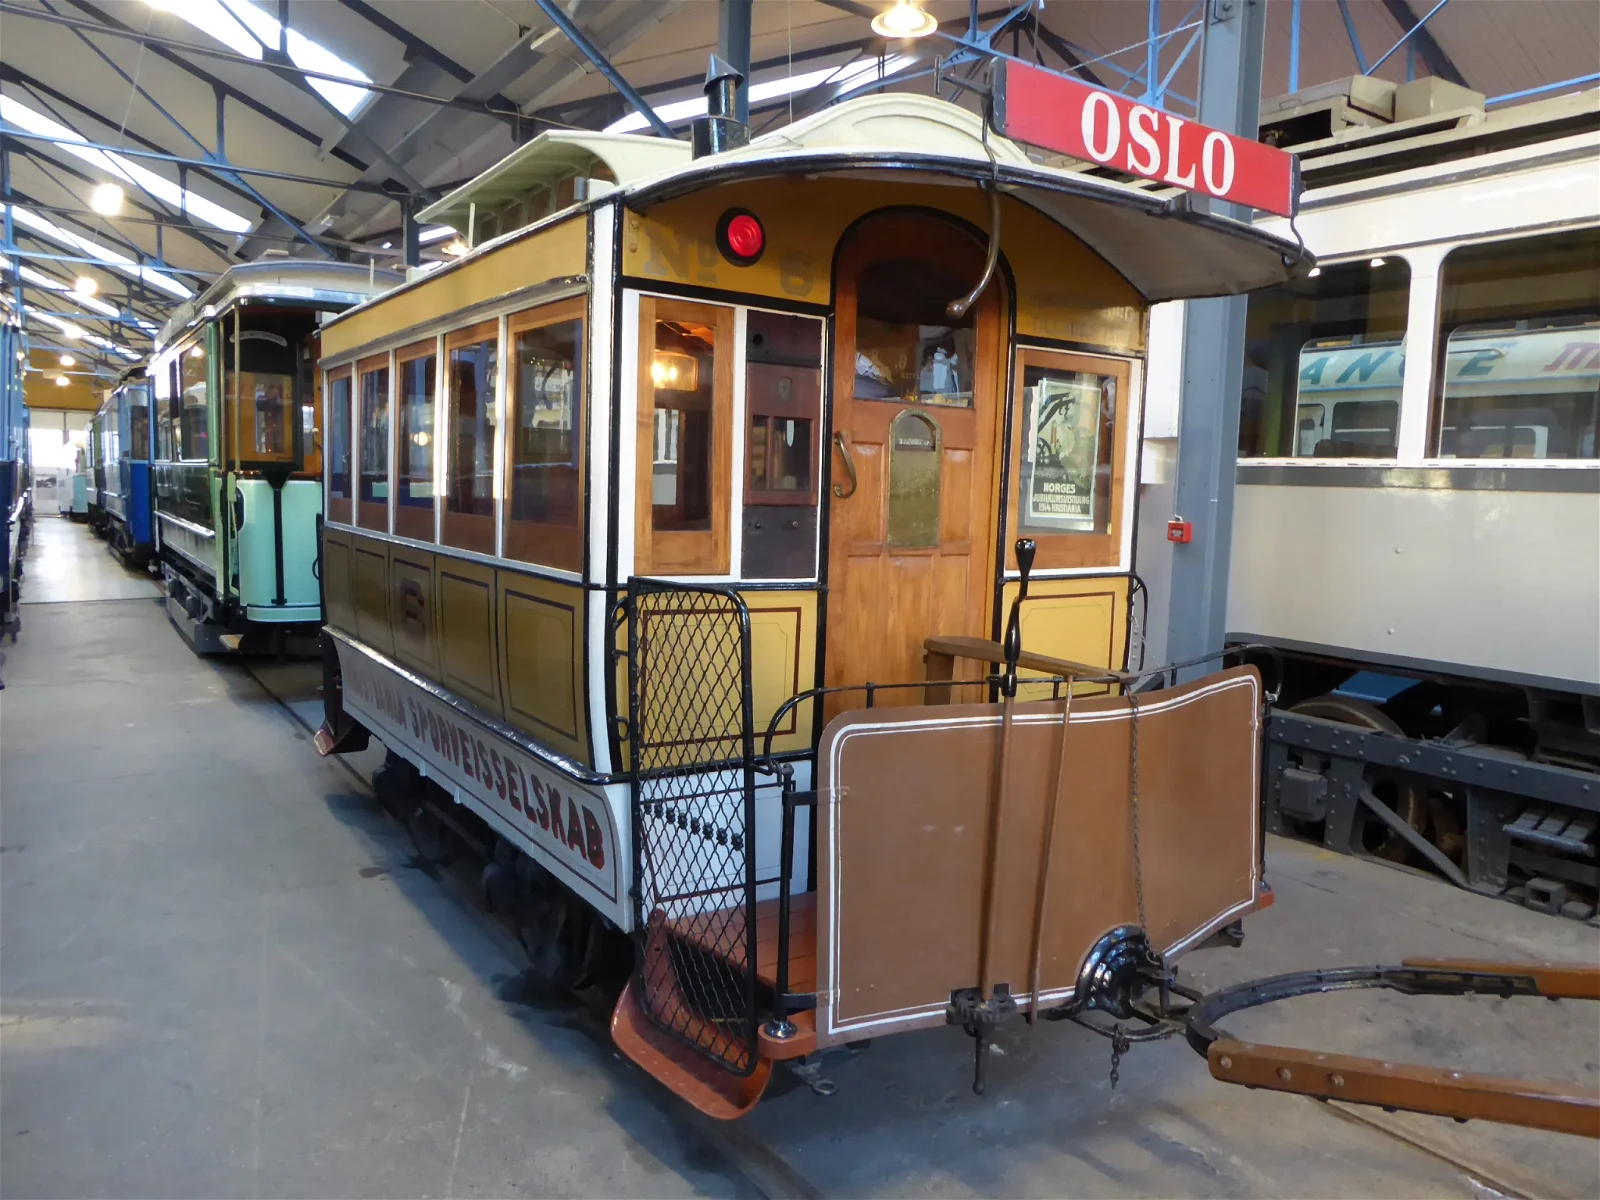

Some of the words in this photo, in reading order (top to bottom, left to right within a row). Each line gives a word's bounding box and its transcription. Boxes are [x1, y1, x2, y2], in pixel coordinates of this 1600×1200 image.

[1081, 91, 1236, 197] OSLO
[780, 250, 815, 298] 6
[1043, 482, 1076, 494] NORGES
[409, 697, 606, 871] SPORVEISSELSKAB
